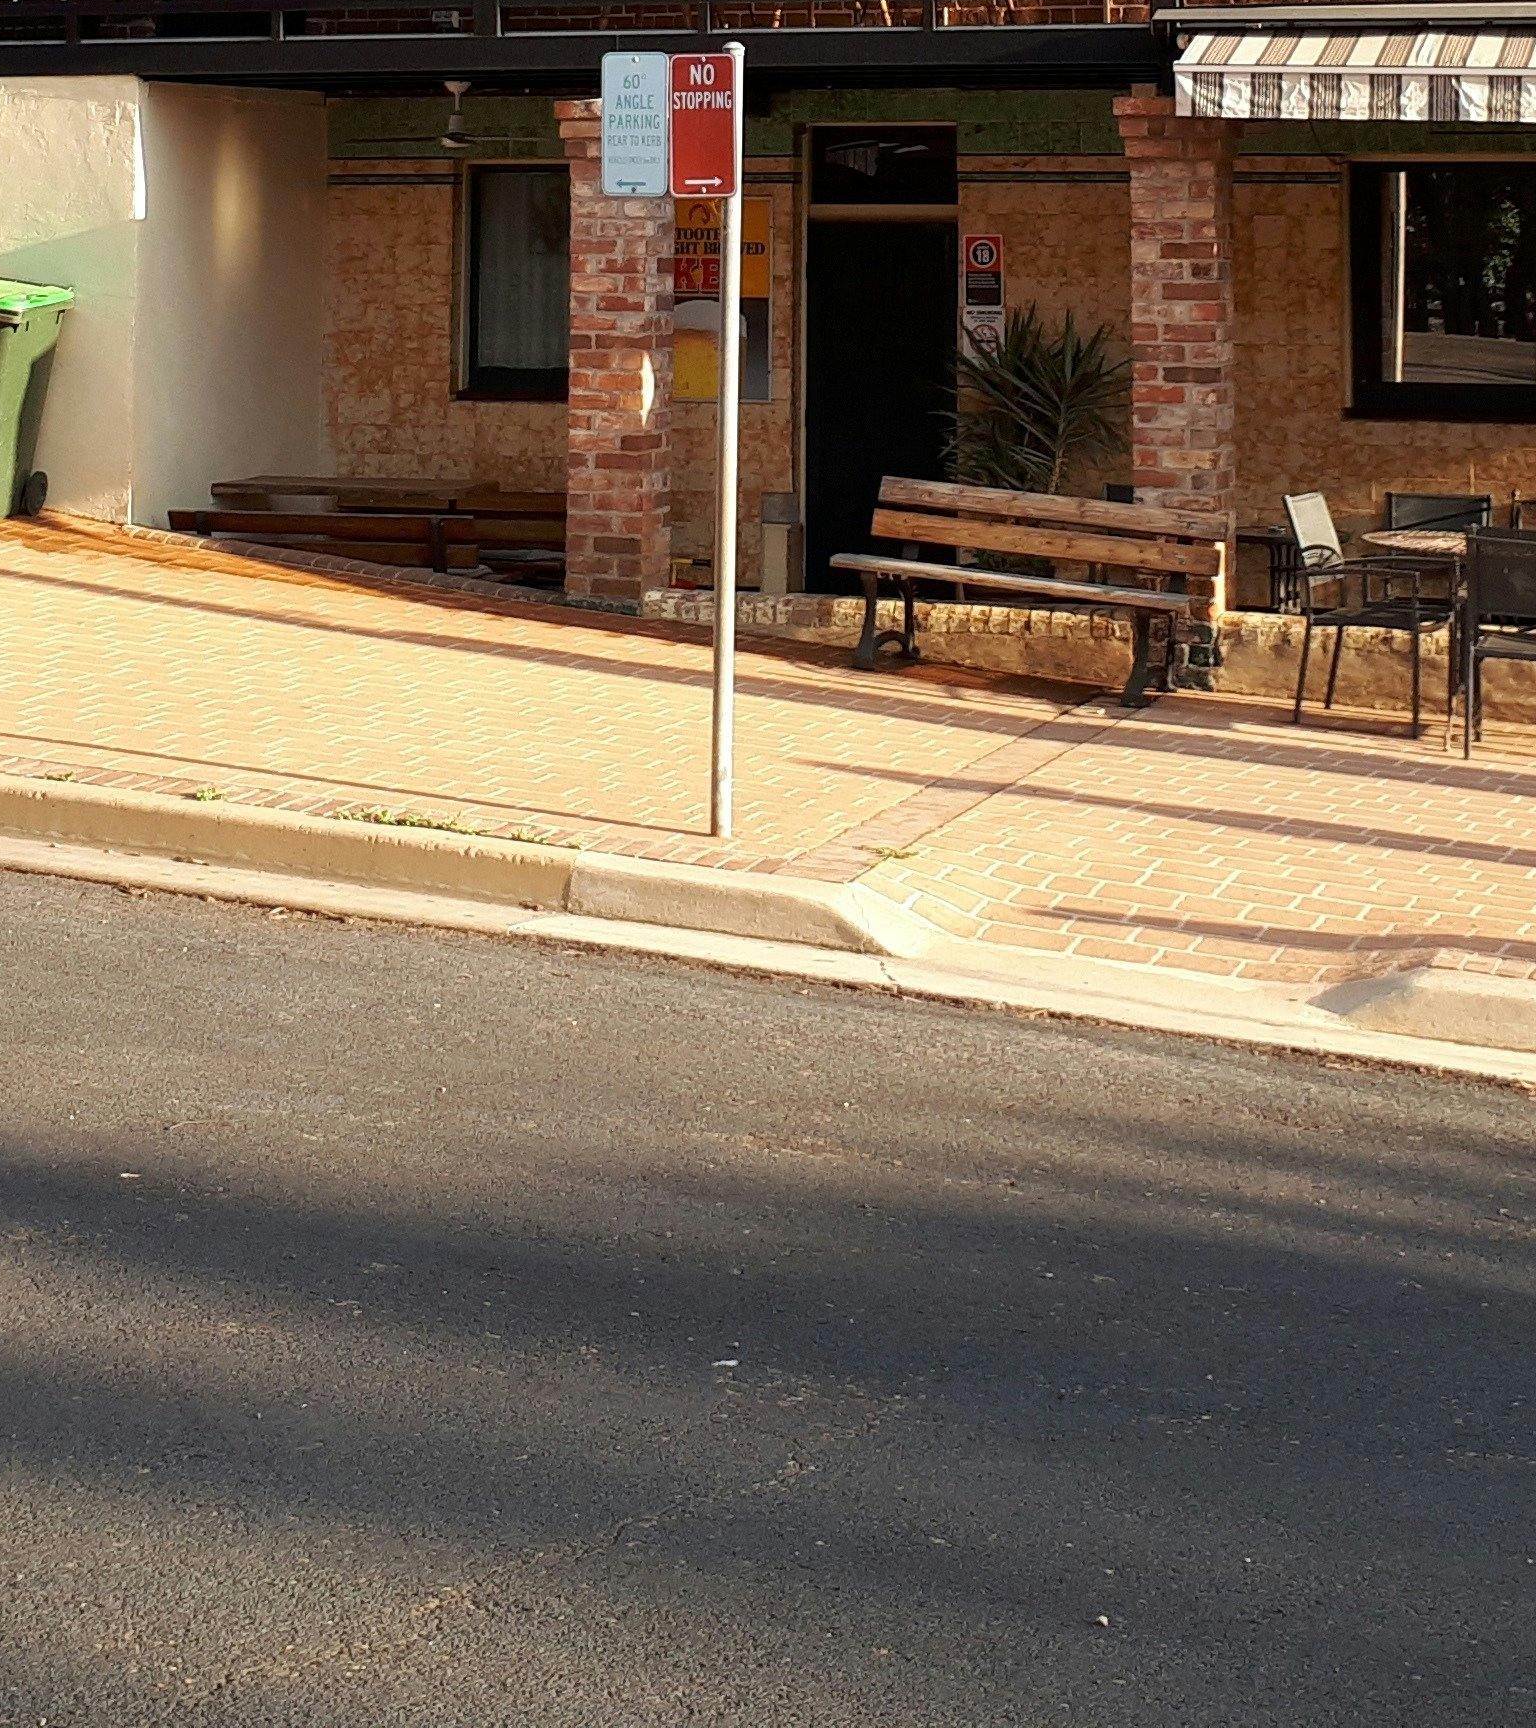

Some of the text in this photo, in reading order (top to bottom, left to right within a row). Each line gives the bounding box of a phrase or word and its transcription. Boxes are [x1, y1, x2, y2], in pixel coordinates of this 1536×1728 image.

[689, 63, 715, 86] NO
[615, 94, 655, 110] ANGLE
[673, 90, 733, 111] STOPPING
[608, 113, 661, 130] PARKING
[607, 134, 662, 147] REAR TO KERB
[975, 249, 990, 263] 18
